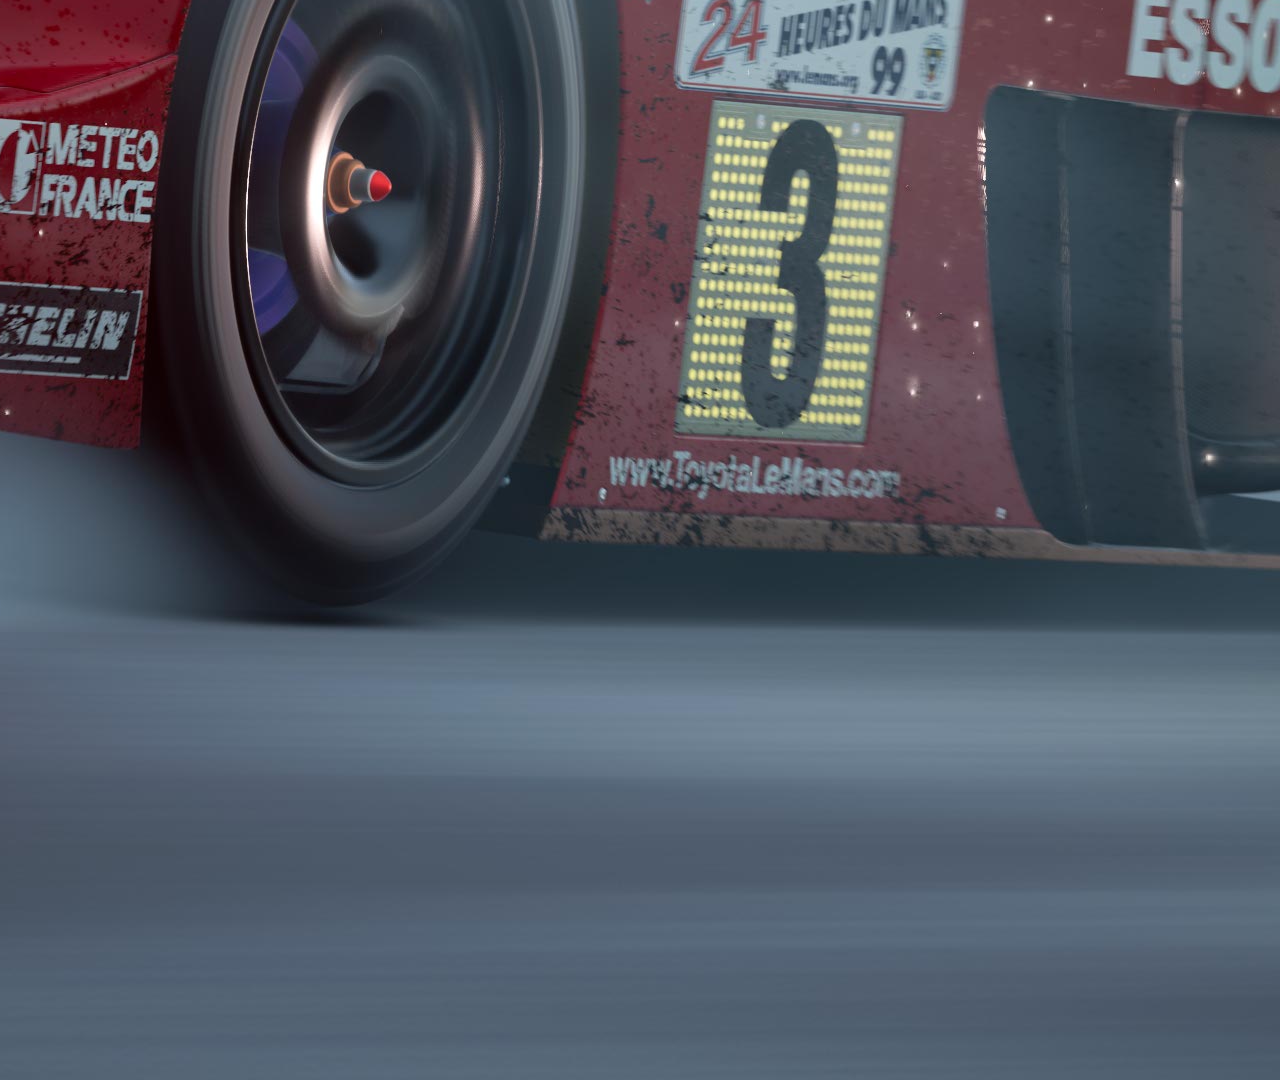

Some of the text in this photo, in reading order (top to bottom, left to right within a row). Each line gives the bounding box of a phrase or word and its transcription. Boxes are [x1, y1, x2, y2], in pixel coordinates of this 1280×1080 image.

[776, 3, 856, 58] HEURES
[870, 45, 906, 95] 99
[46, 122, 159, 173] METEO
[39, 174, 153, 223] FRANCE
[740, 119, 840, 429] 3
[609, 450, 901, 500] www.ToyotaLeMans.com
